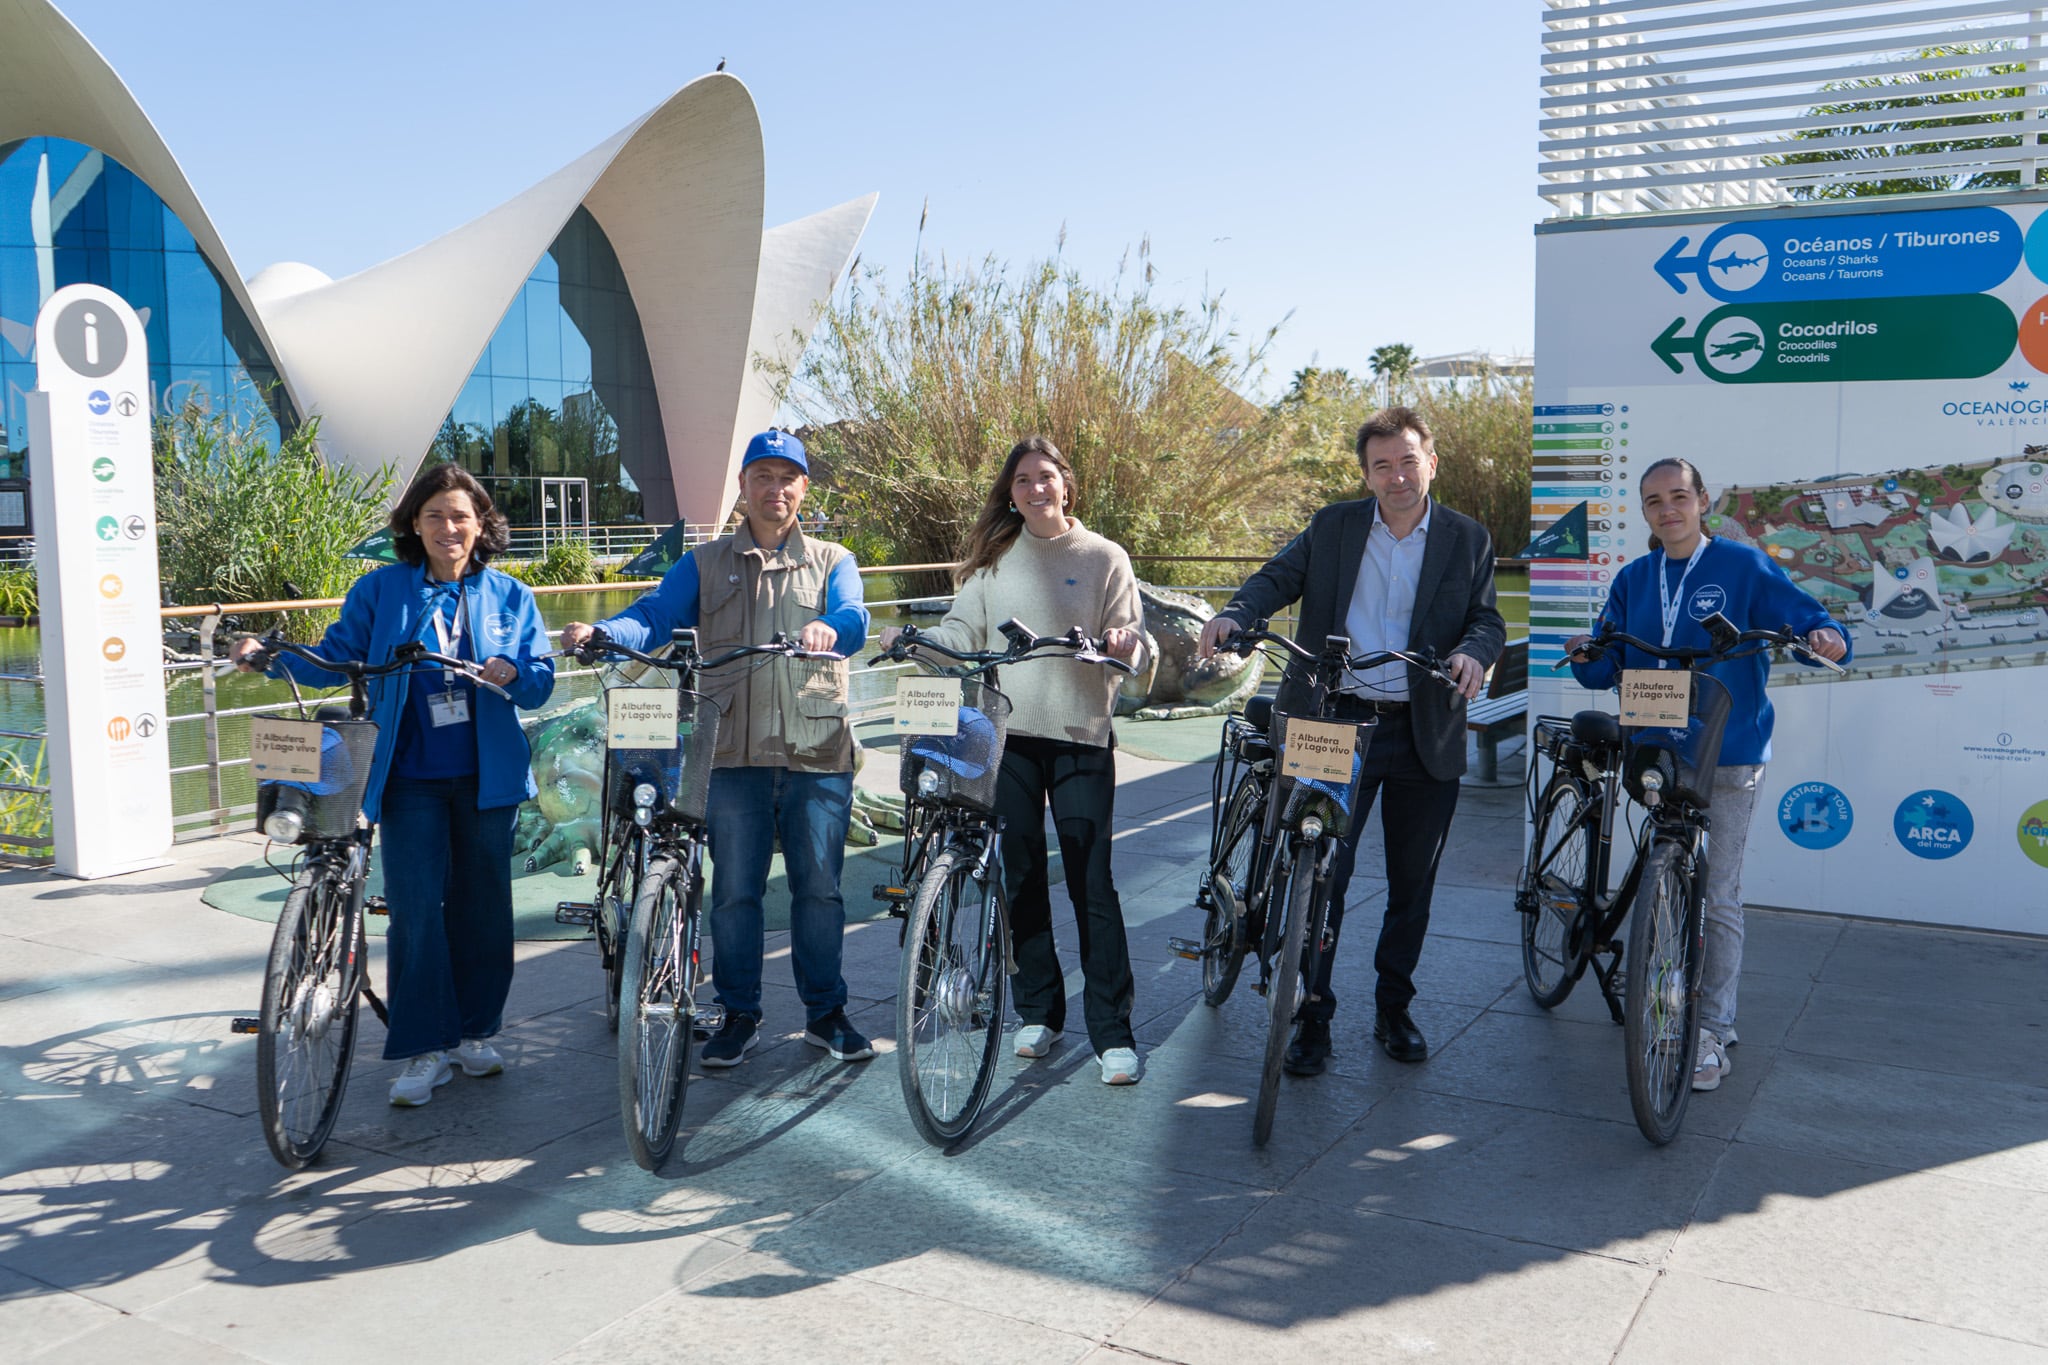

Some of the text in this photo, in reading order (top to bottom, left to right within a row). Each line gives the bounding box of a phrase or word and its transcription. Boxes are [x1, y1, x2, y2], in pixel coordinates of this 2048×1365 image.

[1784, 229, 2000, 254] Océanos / Tiburones
[1783, 254, 1879, 268] Oceans / Sharks
[1782, 268, 1884, 282] Oceans / Taurons
[1779, 320, 1878, 338] Cocodrilos
[1778, 340, 1838, 351] Crocodiles
[1777, 352, 1831, 364] Cocodrils
[1633, 682, 1674, 691] Albufera
[907, 690, 945, 699] Albufera
[1633, 691, 1685, 700] y Lago vivo
[621, 703, 662, 711] Albufera
[907, 699, 956, 709] y Lago vivo
[620, 711, 673, 721] y Lago vivo
[263, 733, 306, 743] Albufera
[1298, 733, 1340, 745] Albufera
[262, 743, 317, 753] y Lago vivo
[1297, 743, 1350, 755] y Lago vivo
[1783, 784, 1849, 821] BACKSTAGE TOUR
[1908, 826, 1962, 843] ARCA
[1917, 840, 1932, 848] del
